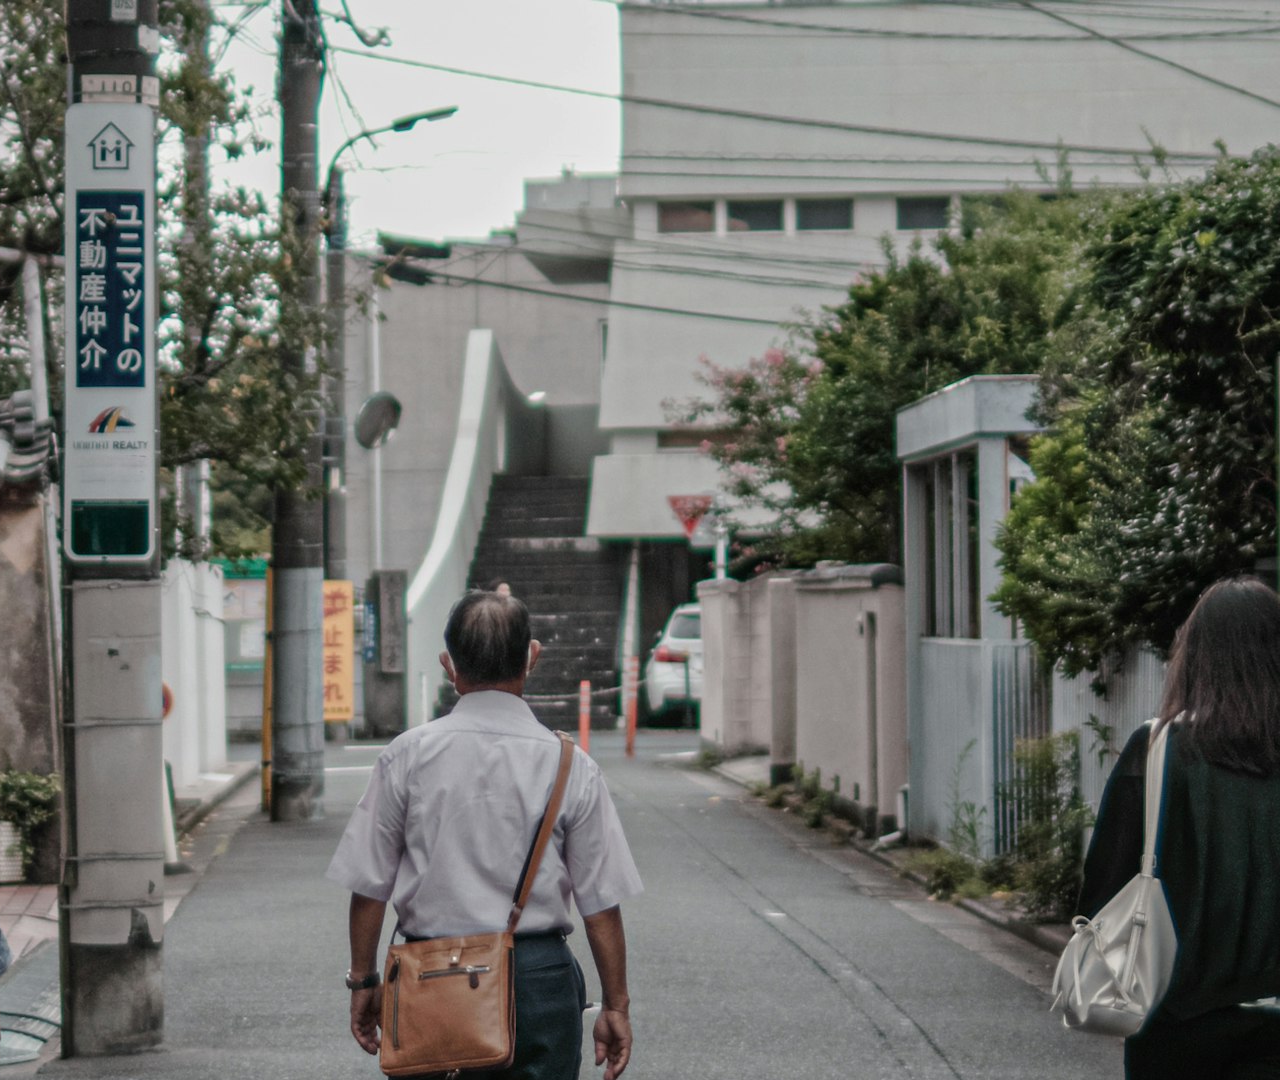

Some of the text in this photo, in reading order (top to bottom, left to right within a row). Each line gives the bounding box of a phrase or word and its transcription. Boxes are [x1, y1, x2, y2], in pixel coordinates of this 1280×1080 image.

[80, 207, 107, 369] 不動産仲介
[116, 204, 142, 372] ユニマットの
[113, 441, 148, 449] REALTY
